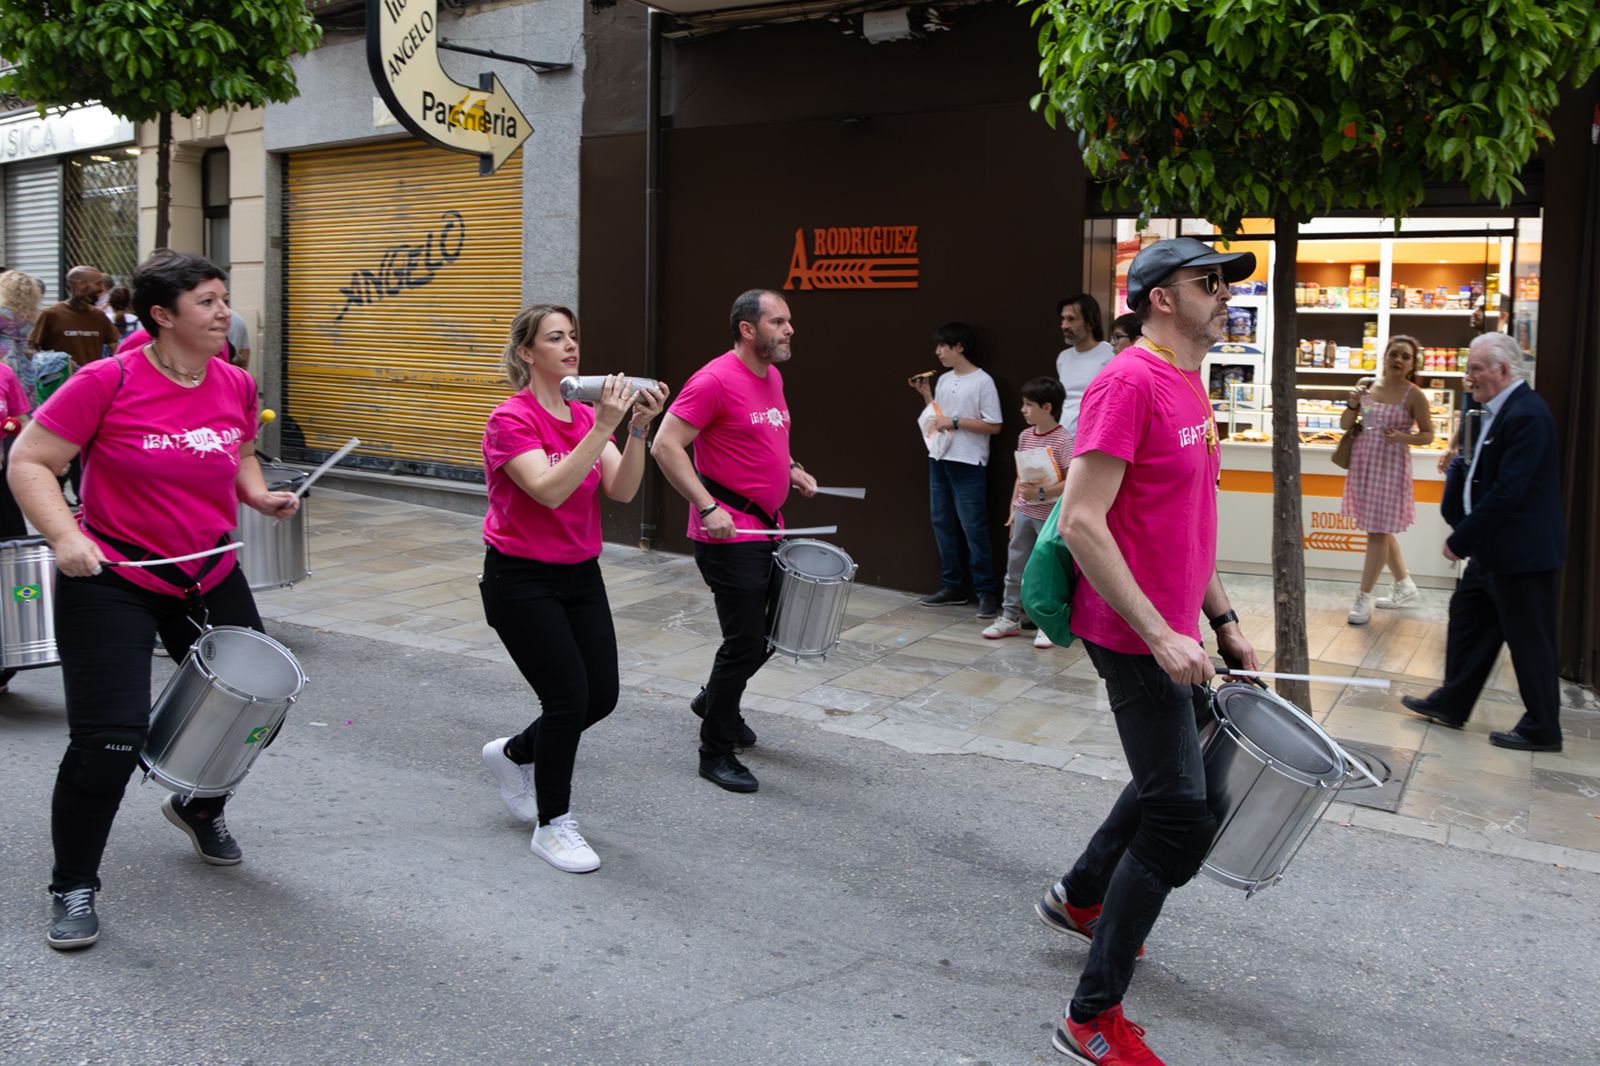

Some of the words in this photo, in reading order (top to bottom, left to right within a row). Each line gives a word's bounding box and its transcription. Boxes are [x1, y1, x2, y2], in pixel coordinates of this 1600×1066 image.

[388, 11, 434, 83] ANGELO
[334, 210, 465, 322] ANGELO
[813, 226, 919, 255] RODRIGUEZ
